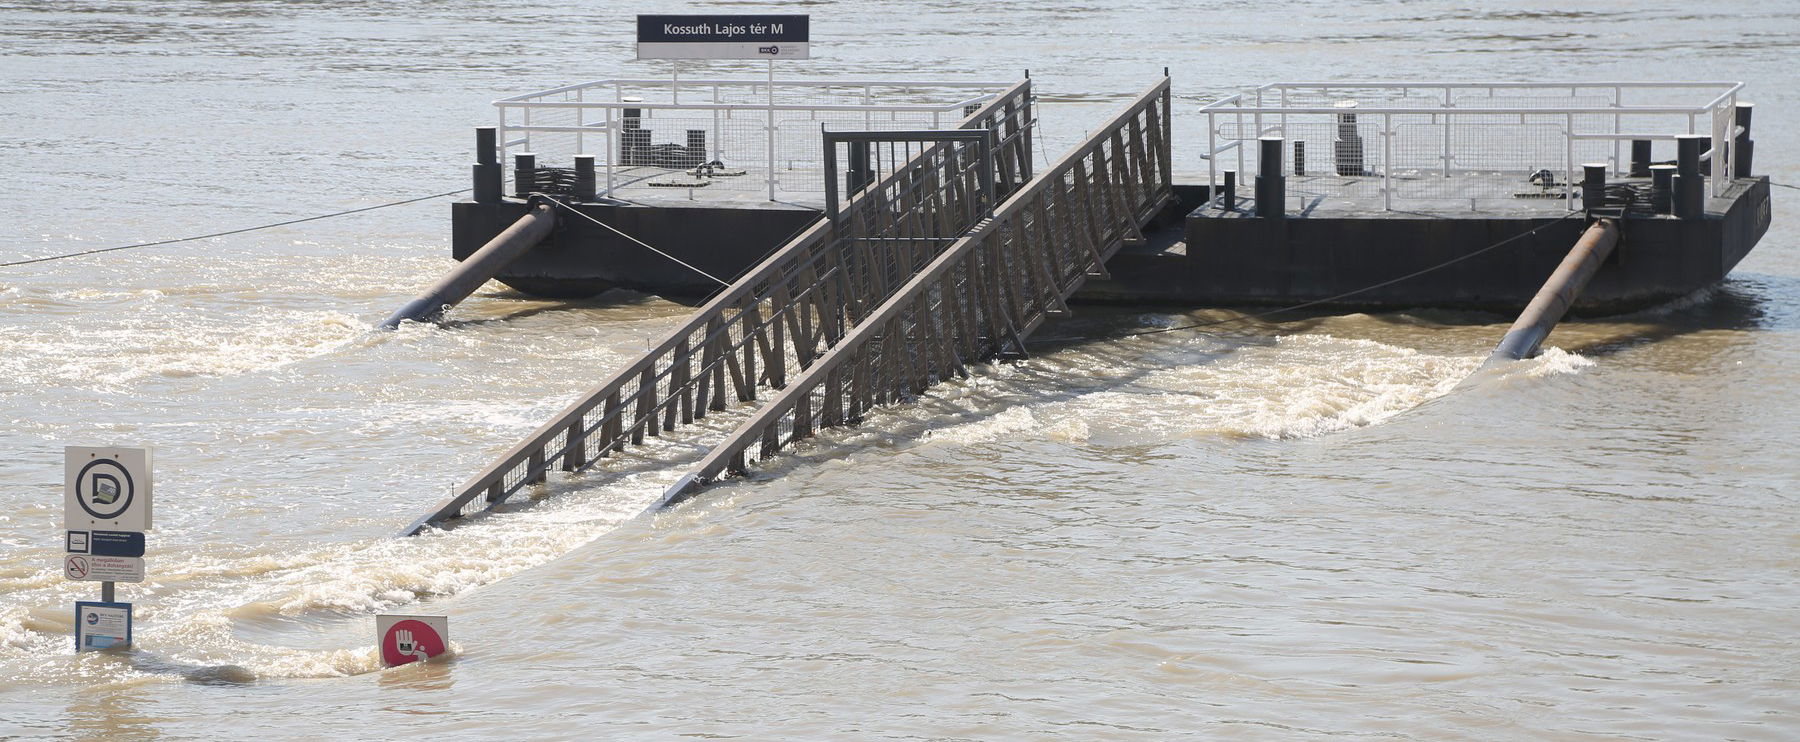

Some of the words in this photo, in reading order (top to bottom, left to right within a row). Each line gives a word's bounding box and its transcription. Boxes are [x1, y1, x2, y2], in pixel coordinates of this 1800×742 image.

[664, 23, 711, 35] Kossuth
[715, 23, 746, 37] Lajos
[750, 22, 767, 35] tér
[771, 23, 784, 35] M
